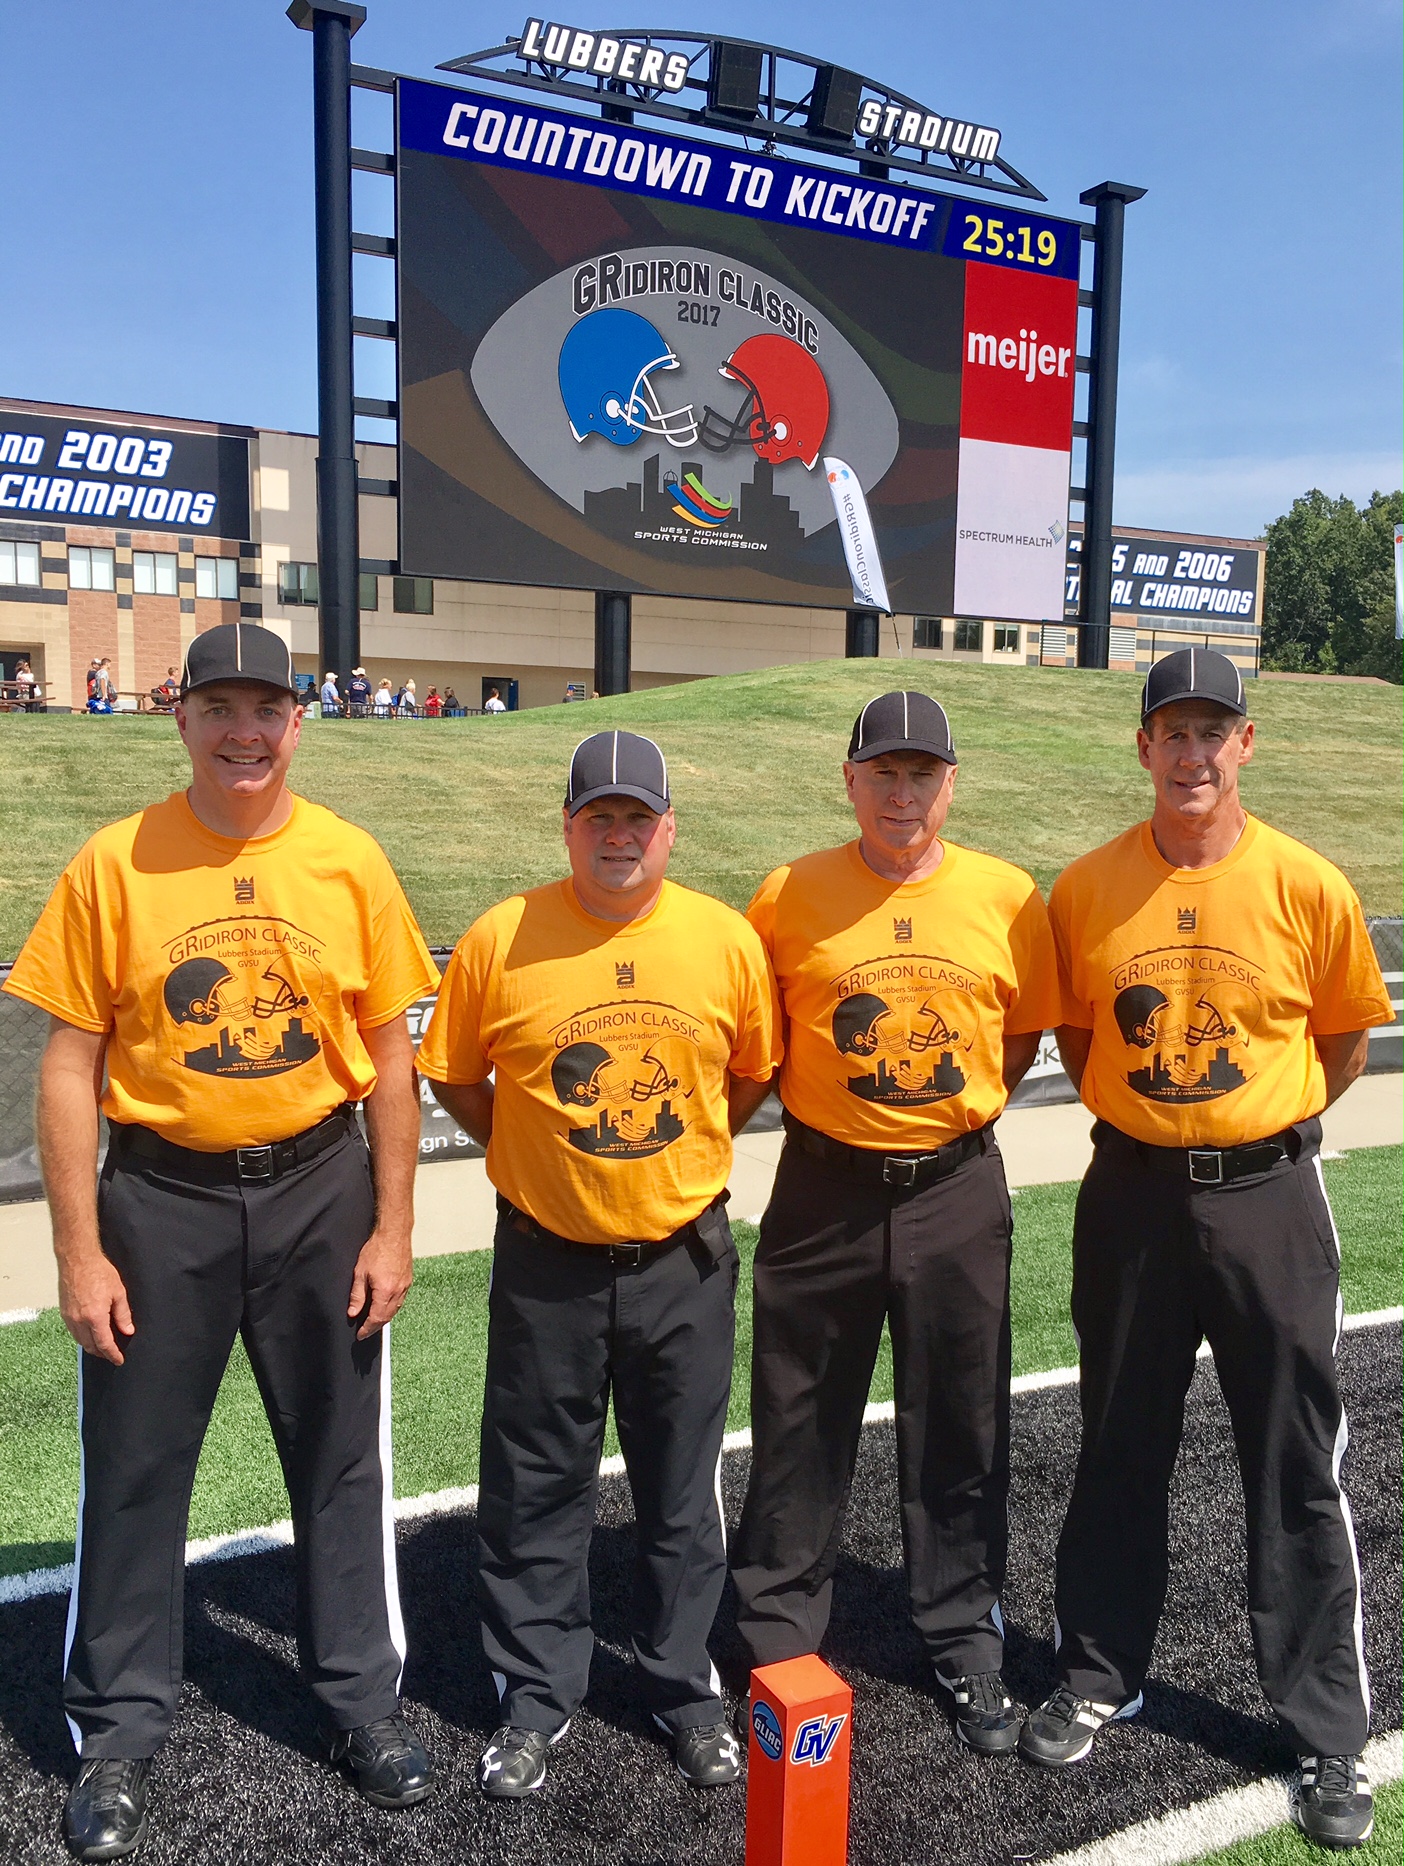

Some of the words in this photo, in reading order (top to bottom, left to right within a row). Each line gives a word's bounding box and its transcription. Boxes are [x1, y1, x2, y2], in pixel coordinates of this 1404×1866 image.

[521, 20, 689, 91] LUBBERS
[859, 99, 1000, 162] STADIUM
[442, 101, 712, 197] COUNTDOWN
[729, 160, 774, 209] TO
[785, 177, 936, 240] KICKOFF
[962, 214, 1057, 267] 25:19
[572, 252, 712, 316] GRIDIRON
[717, 268, 819, 355] CLASSIC
[677, 300, 721, 327] 2017
[967, 328, 1072, 383] meijer
[0, 433, 46, 466] ND
[57, 430, 174, 479] 2003
[0, 473, 218, 527] CHAMPIONS
[633, 531, 688, 544] SPORTS
[691, 537, 768, 551] COMMISSION
[659, 526, 691, 535] WEST
[693, 529, 744, 540] MICHIGAN
[959, 529, 1014, 544] SPECTRUM
[1015, 535, 1053, 548] HEALTH
[1132, 553, 1169, 576] AND
[1172, 550, 1235, 582] 2006
[1139, 582, 1254, 615] CHAMPIONS
[217, 950, 249, 958] Lubbers
[249, 948, 282, 957] Stadium
[262, 928, 322, 964] CLASSIC
[237, 960, 259, 968] GVSU
[1198, 957, 1261, 991] CLASSIC
[877, 986, 906, 994] Lubbers
[907, 984, 937, 993] Stadium
[918, 966, 977, 996] CLASSIC
[1156, 978, 1186, 986] Lubbers
[1187, 976, 1215, 985] Stadium
[1175, 988, 1195, 996] GVSU
[896, 996, 916, 1004] GVSU
[599, 1034, 629, 1043] Lubbers
[629, 1031, 660, 1040] Stadium
[641, 1012, 701, 1043] CLASSIC
[618, 1043, 639, 1052] GVSU
[251, 1059, 303, 1071] COMMISSION
[905, 1091, 952, 1099] COMMISSION
[627, 1140, 669, 1152] COMMISSION
[629, 1139, 660, 1147] MICHIGAN
[753, 1717, 782, 1752] GLIAC
[790, 1714, 848, 1767] GV
